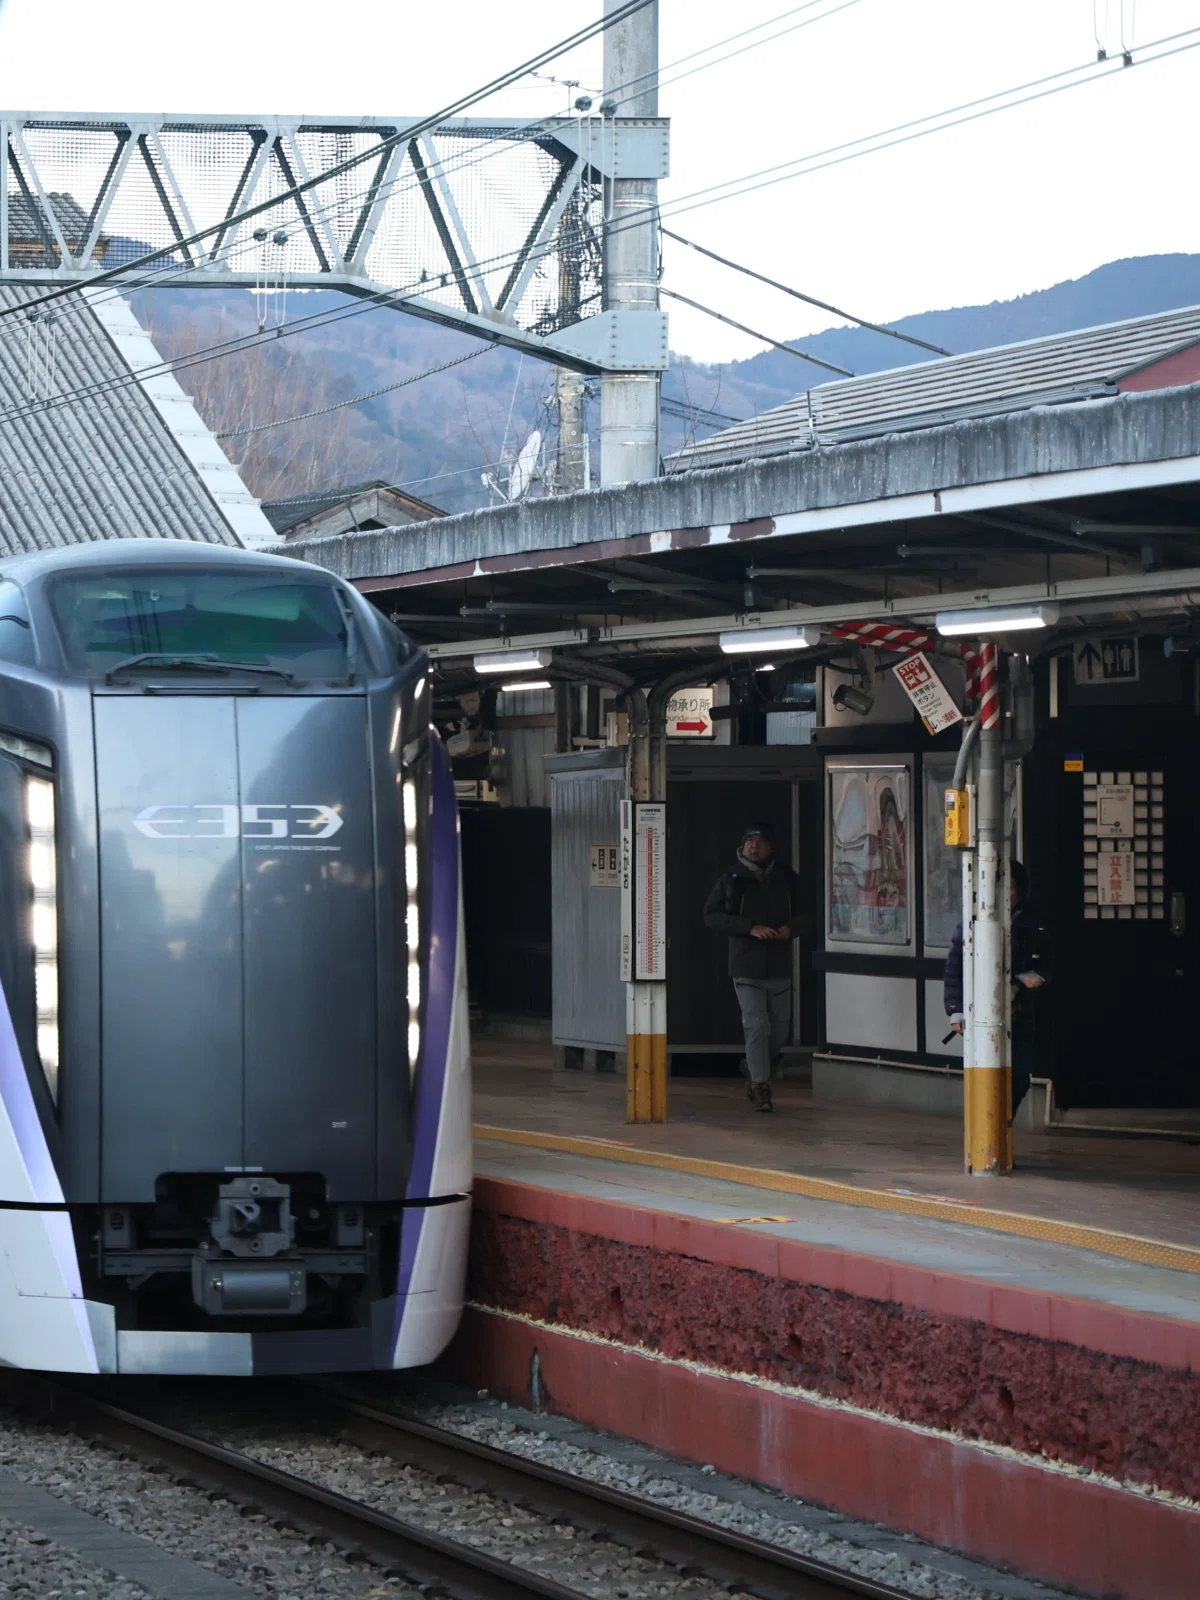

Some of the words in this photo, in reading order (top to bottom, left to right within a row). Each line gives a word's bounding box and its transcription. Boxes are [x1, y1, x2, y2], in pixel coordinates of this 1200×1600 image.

[900, 659, 921, 675] STOP
[912, 682, 937, 698] 非常停止
[668, 698, 710, 712] 物承り所
[917, 693, 935, 705] ボタン
[132, 804, 345, 838] E353
[1109, 855, 1123, 903] 立入禁止
